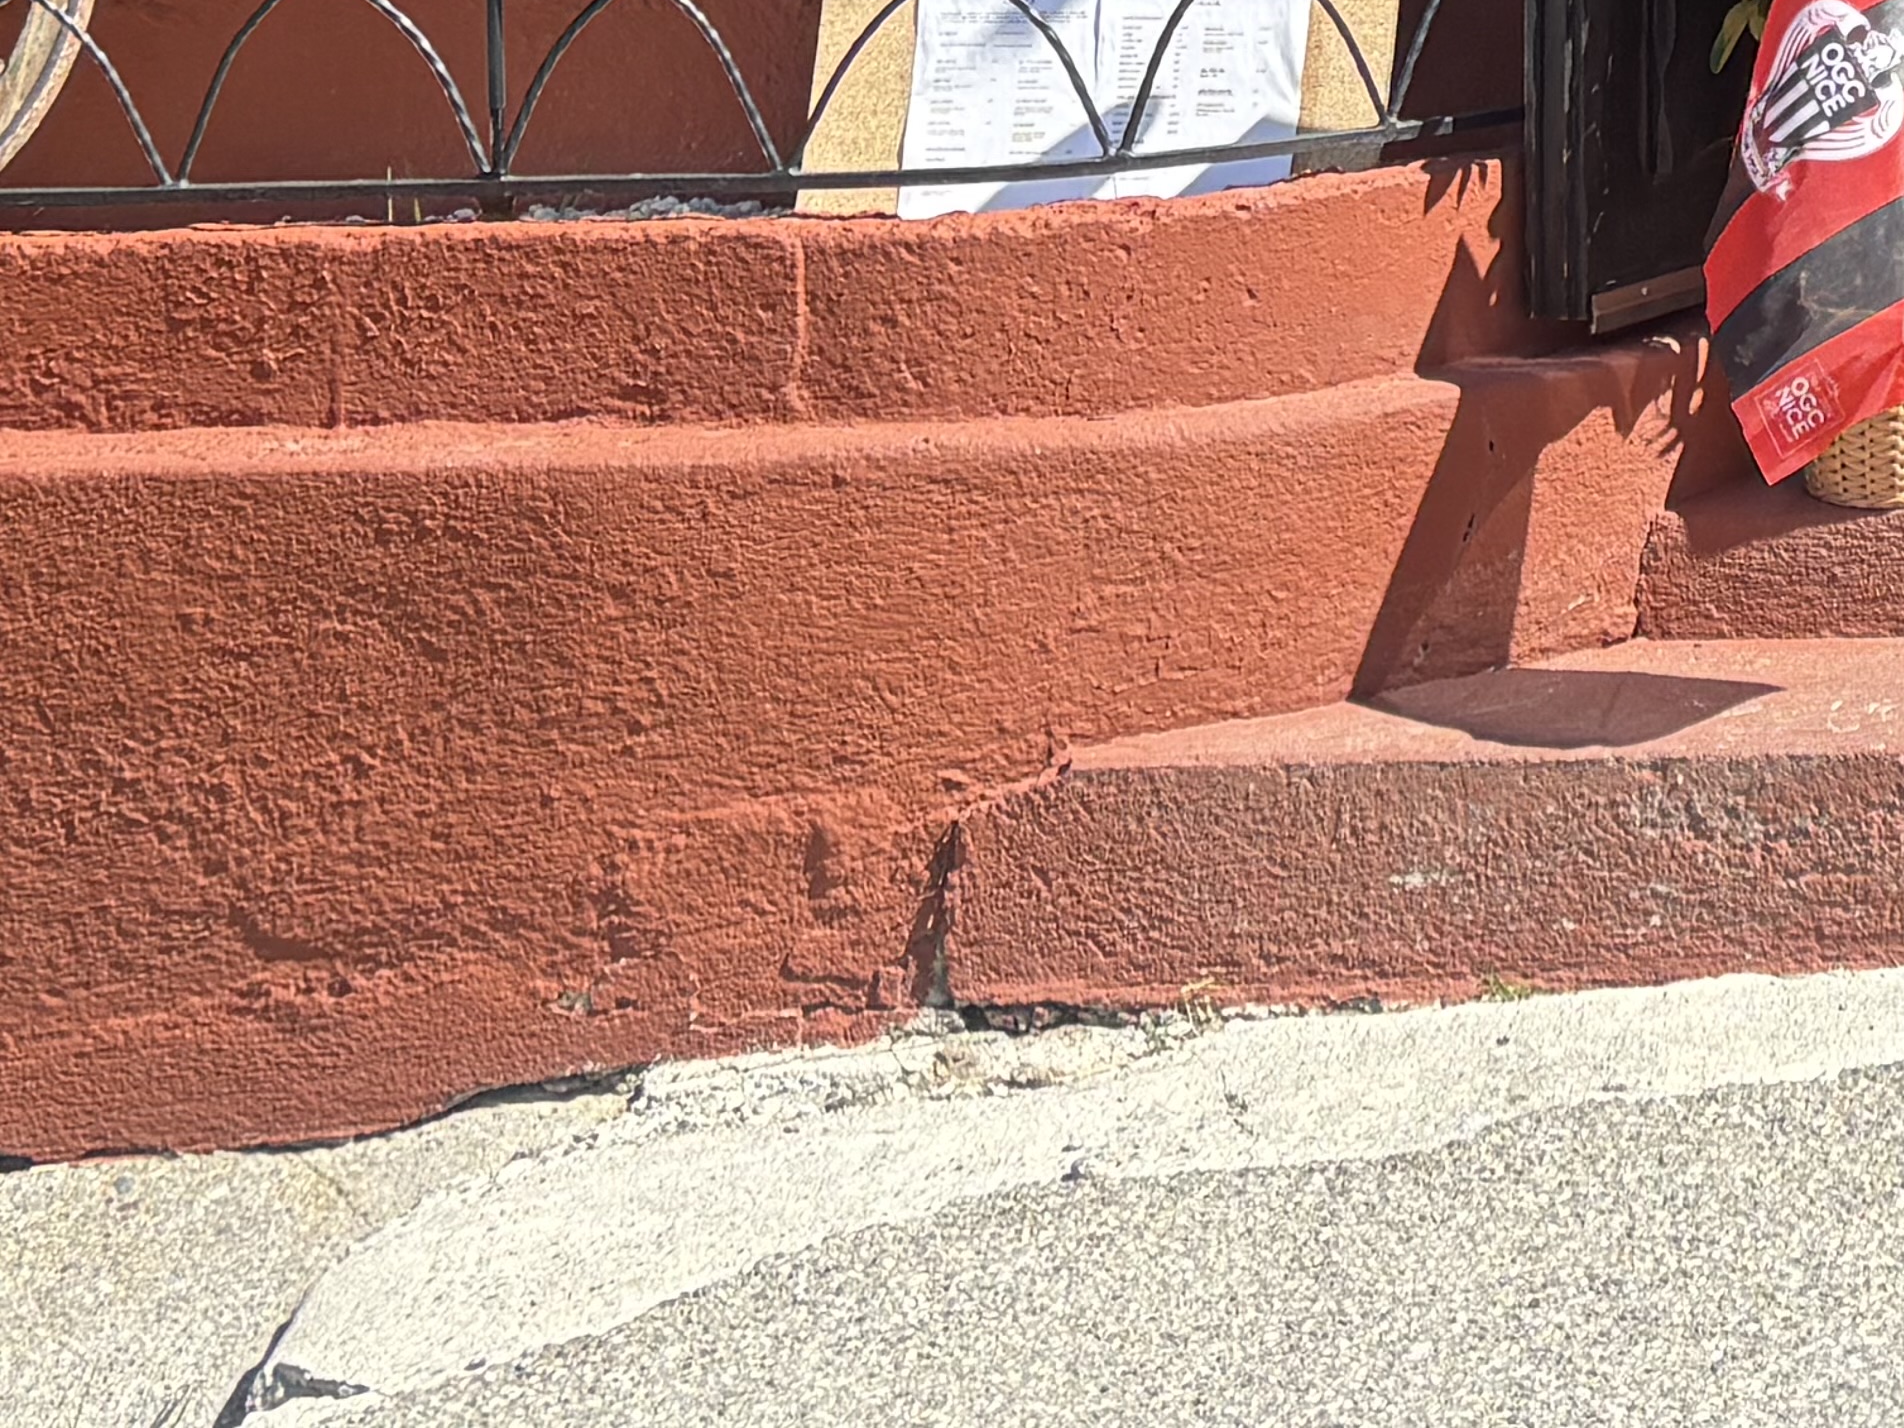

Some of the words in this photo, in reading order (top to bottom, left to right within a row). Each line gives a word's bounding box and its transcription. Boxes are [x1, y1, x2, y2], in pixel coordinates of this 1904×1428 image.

[1801, 50, 1847, 118] NICE
[1819, 41, 1868, 108] OGC
[1775, 386, 1810, 441] NICE
[1790, 376, 1826, 427] OGC
